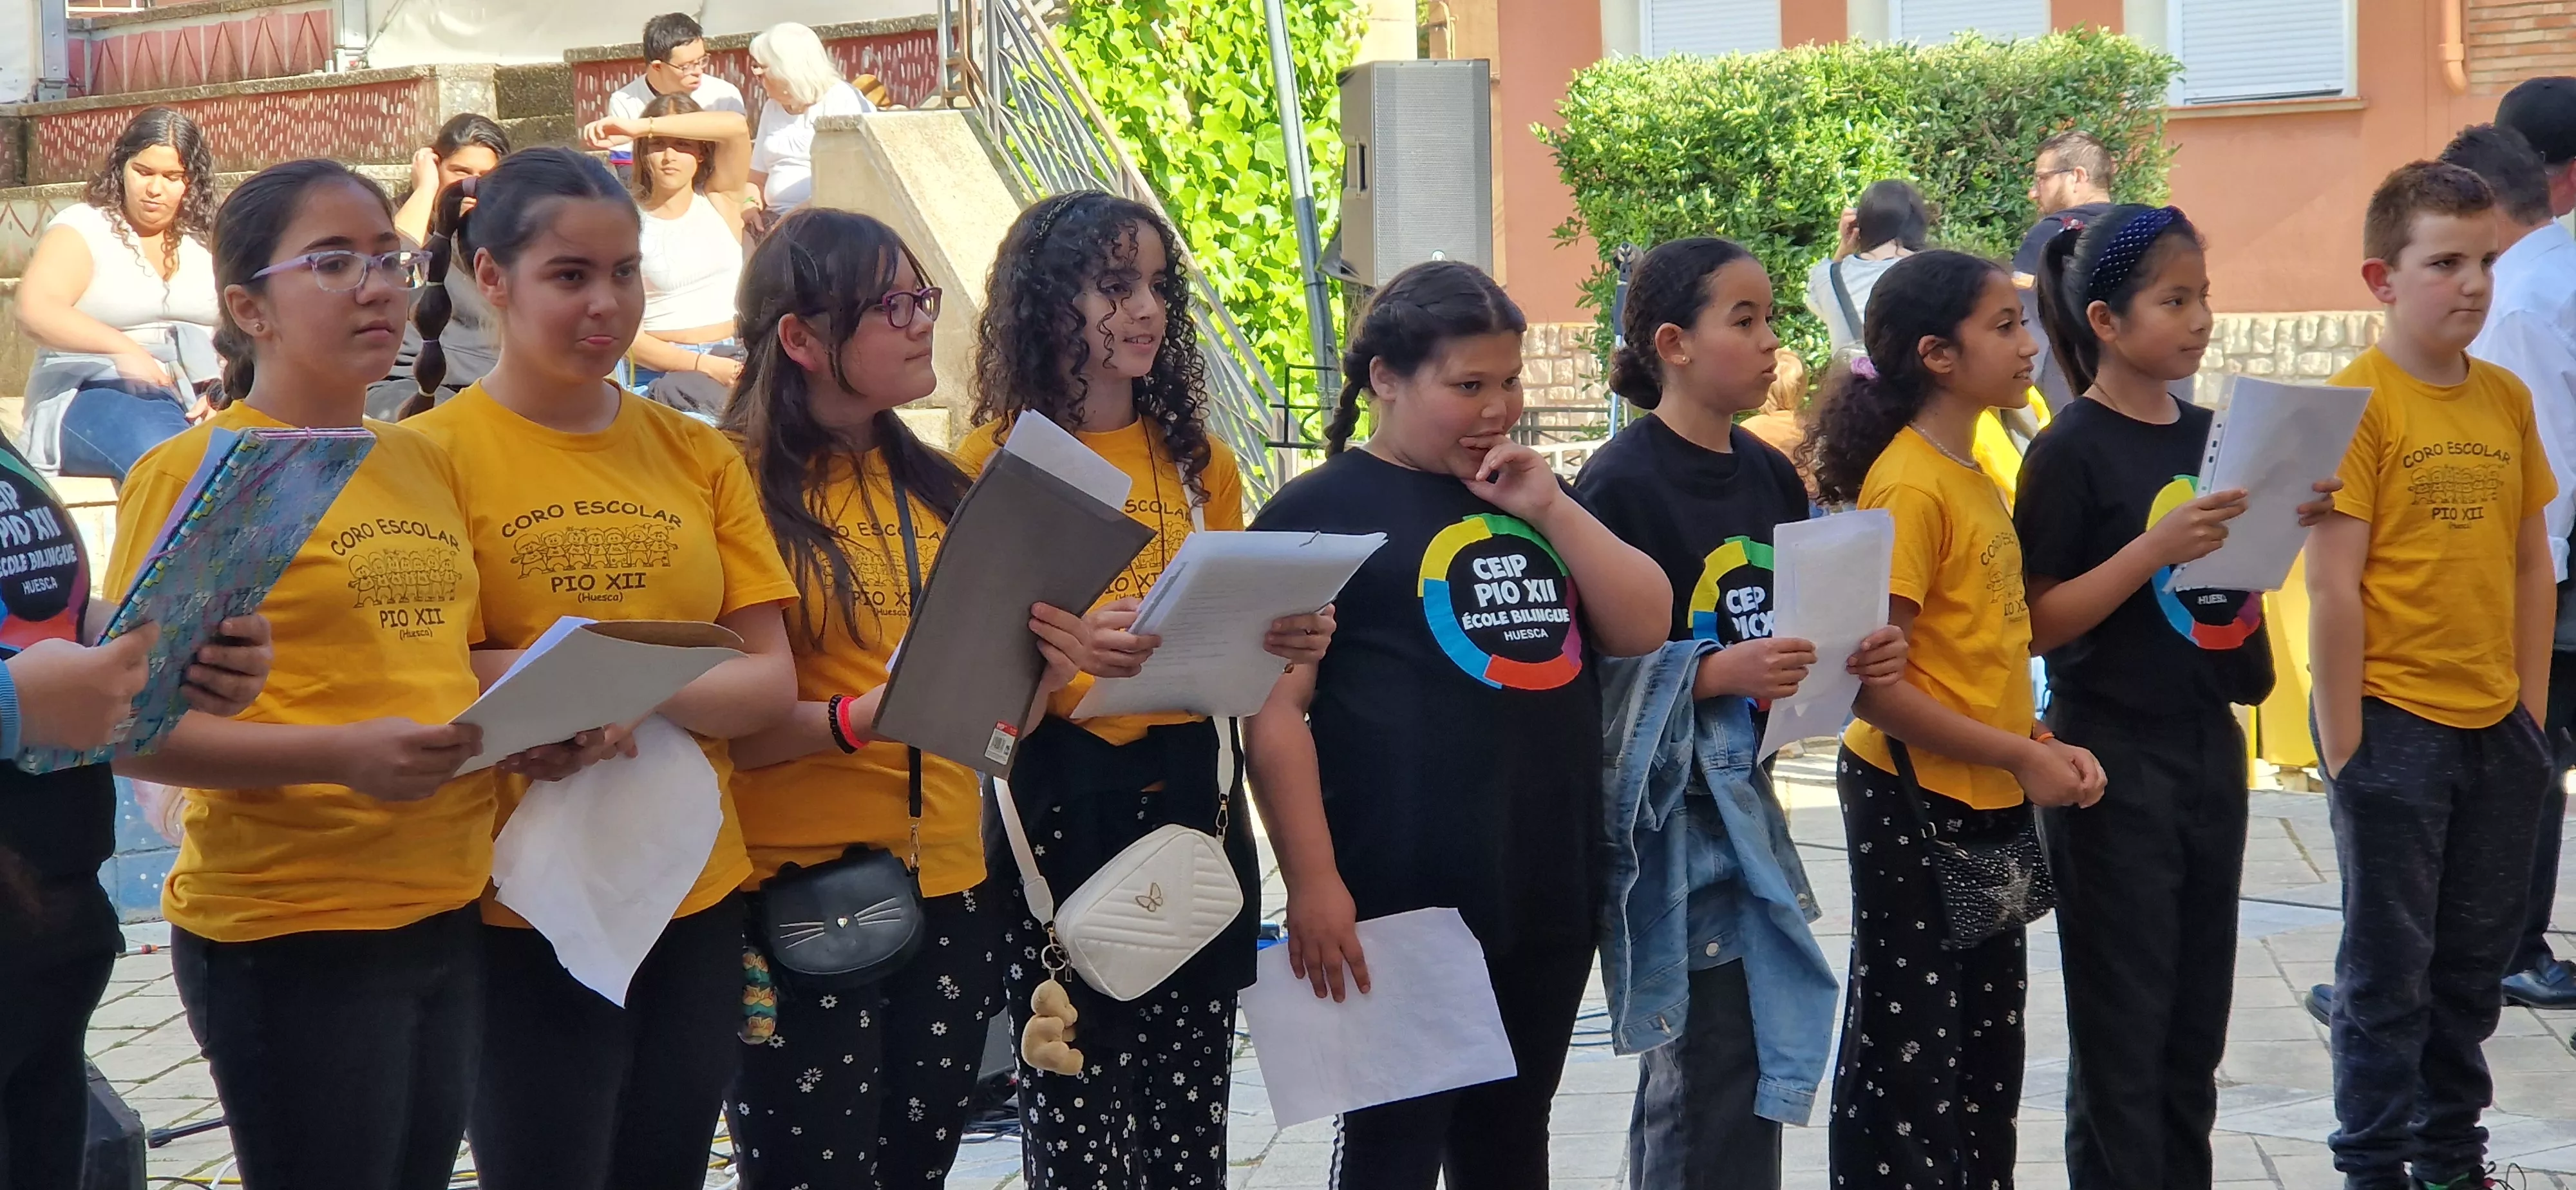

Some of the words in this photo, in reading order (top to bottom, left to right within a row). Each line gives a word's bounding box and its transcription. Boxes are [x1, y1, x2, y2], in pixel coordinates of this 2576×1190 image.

[2403, 443, 2443, 468] CORO
[2447, 441, 2511, 465] ESCOLAR
[0, 480, 20, 513] IP
[24, 506, 61, 540] XII
[501, 504, 564, 538] CORO
[574, 500, 682, 528] ESCOLAR
[2432, 507, 2458, 520] PIO
[2462, 507, 2484, 521] XII
[330, 522, 374, 556] CORO
[375, 518, 460, 552] ESCOLAR
[857, 522, 942, 542] ESCLA
[0, 553, 28, 578] COLE
[27, 543, 77, 571] BILINGUE
[1473, 554, 1527, 580] CEIP
[21, 576, 58, 595] HUESCA
[551, 574, 596, 592] PIO
[605, 572, 647, 590] XII
[1474, 580, 1520, 607] PIO
[1522, 578, 1558, 603] XII
[577, 592, 623, 603] (Huesca)
[379, 609, 409, 629] PIO
[414, 608, 445, 625] XII
[875, 607, 911, 618] Huesca)
[1461, 612, 1510, 630] ÉCOLE
[1510, 608, 1570, 624] BILINGUE
[1504, 628, 1549, 641] HUESCA
